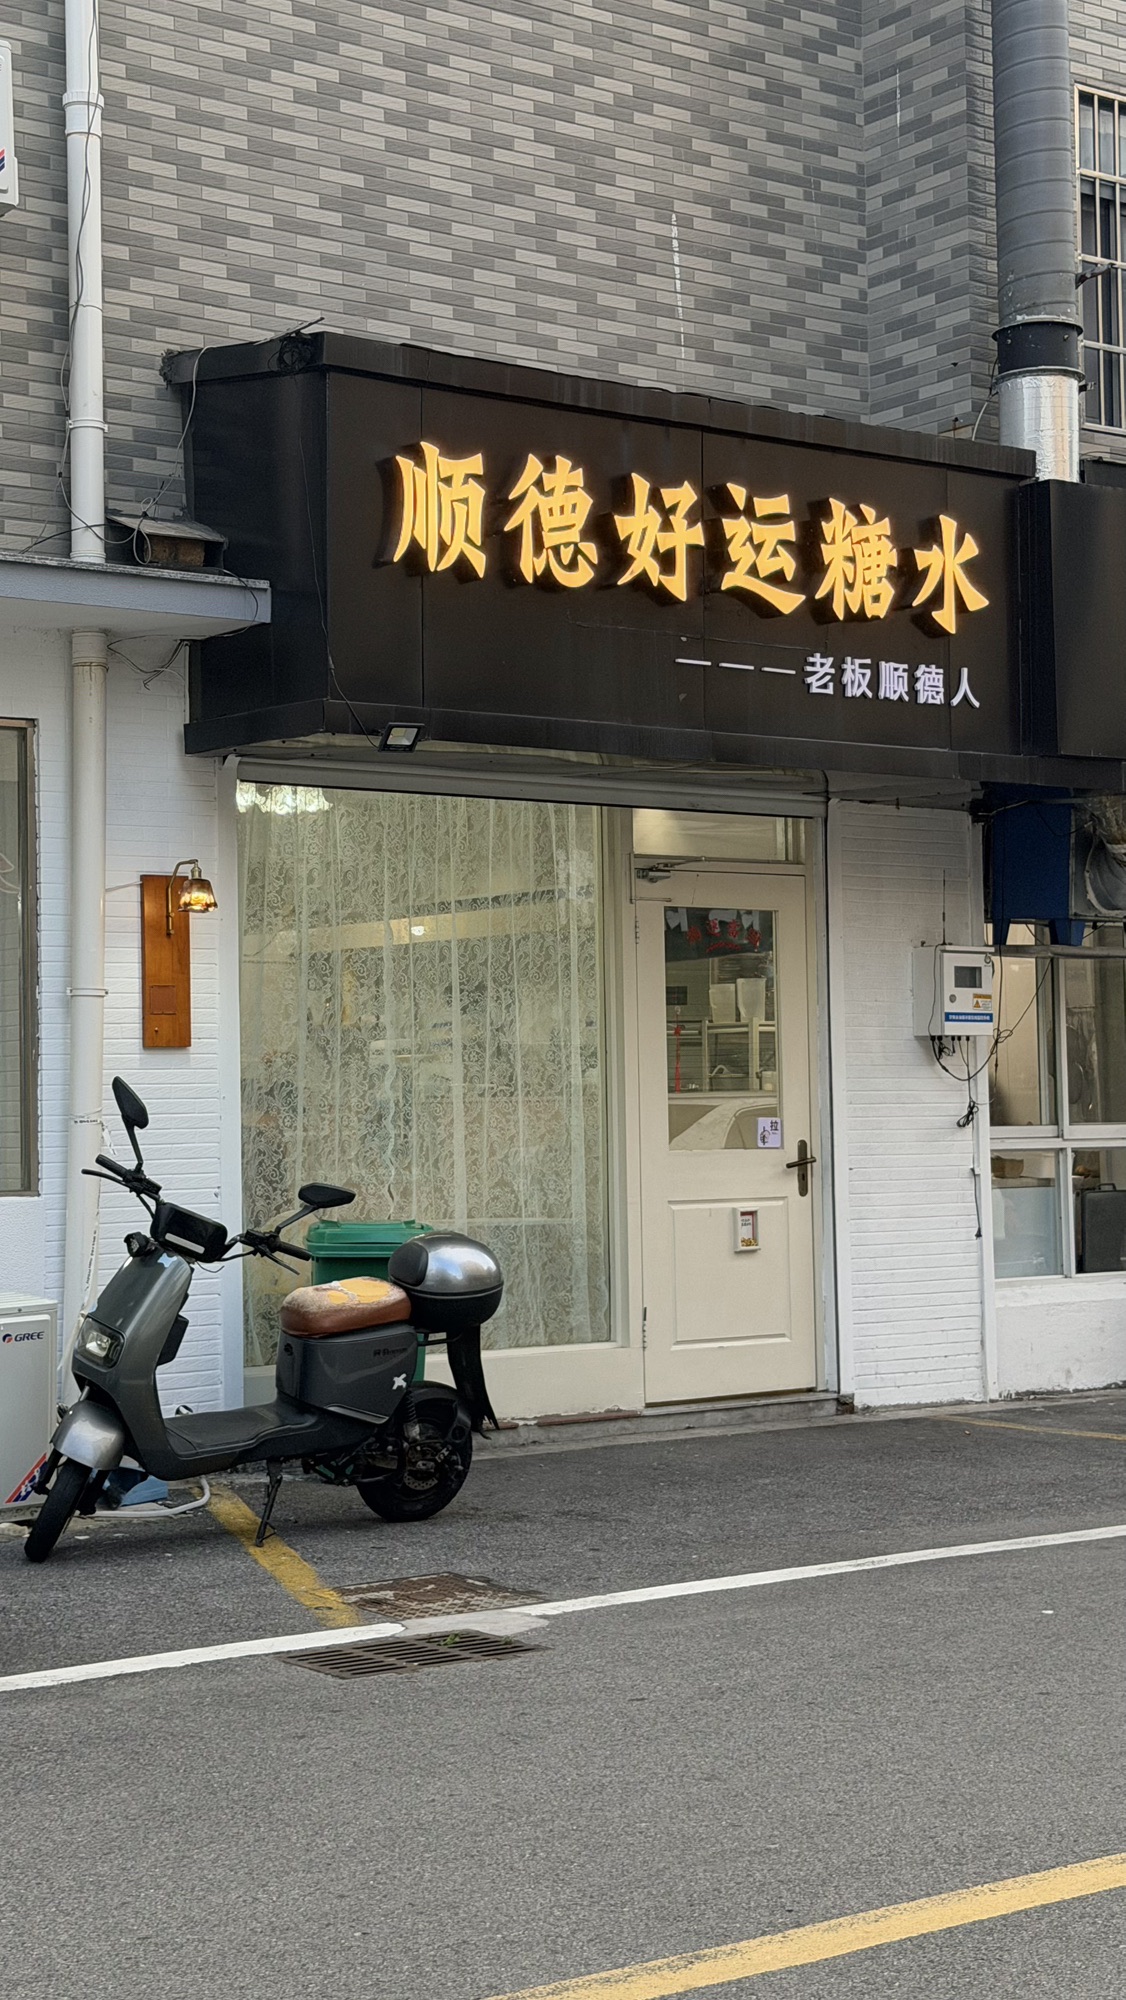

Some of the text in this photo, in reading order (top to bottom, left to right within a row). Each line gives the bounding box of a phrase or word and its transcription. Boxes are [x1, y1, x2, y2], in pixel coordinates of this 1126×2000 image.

[393, 441, 990, 635] 顺德好运糖水
[769, 1119, 780, 1132] 拉
[14, 1331, 45, 1342] GREE
